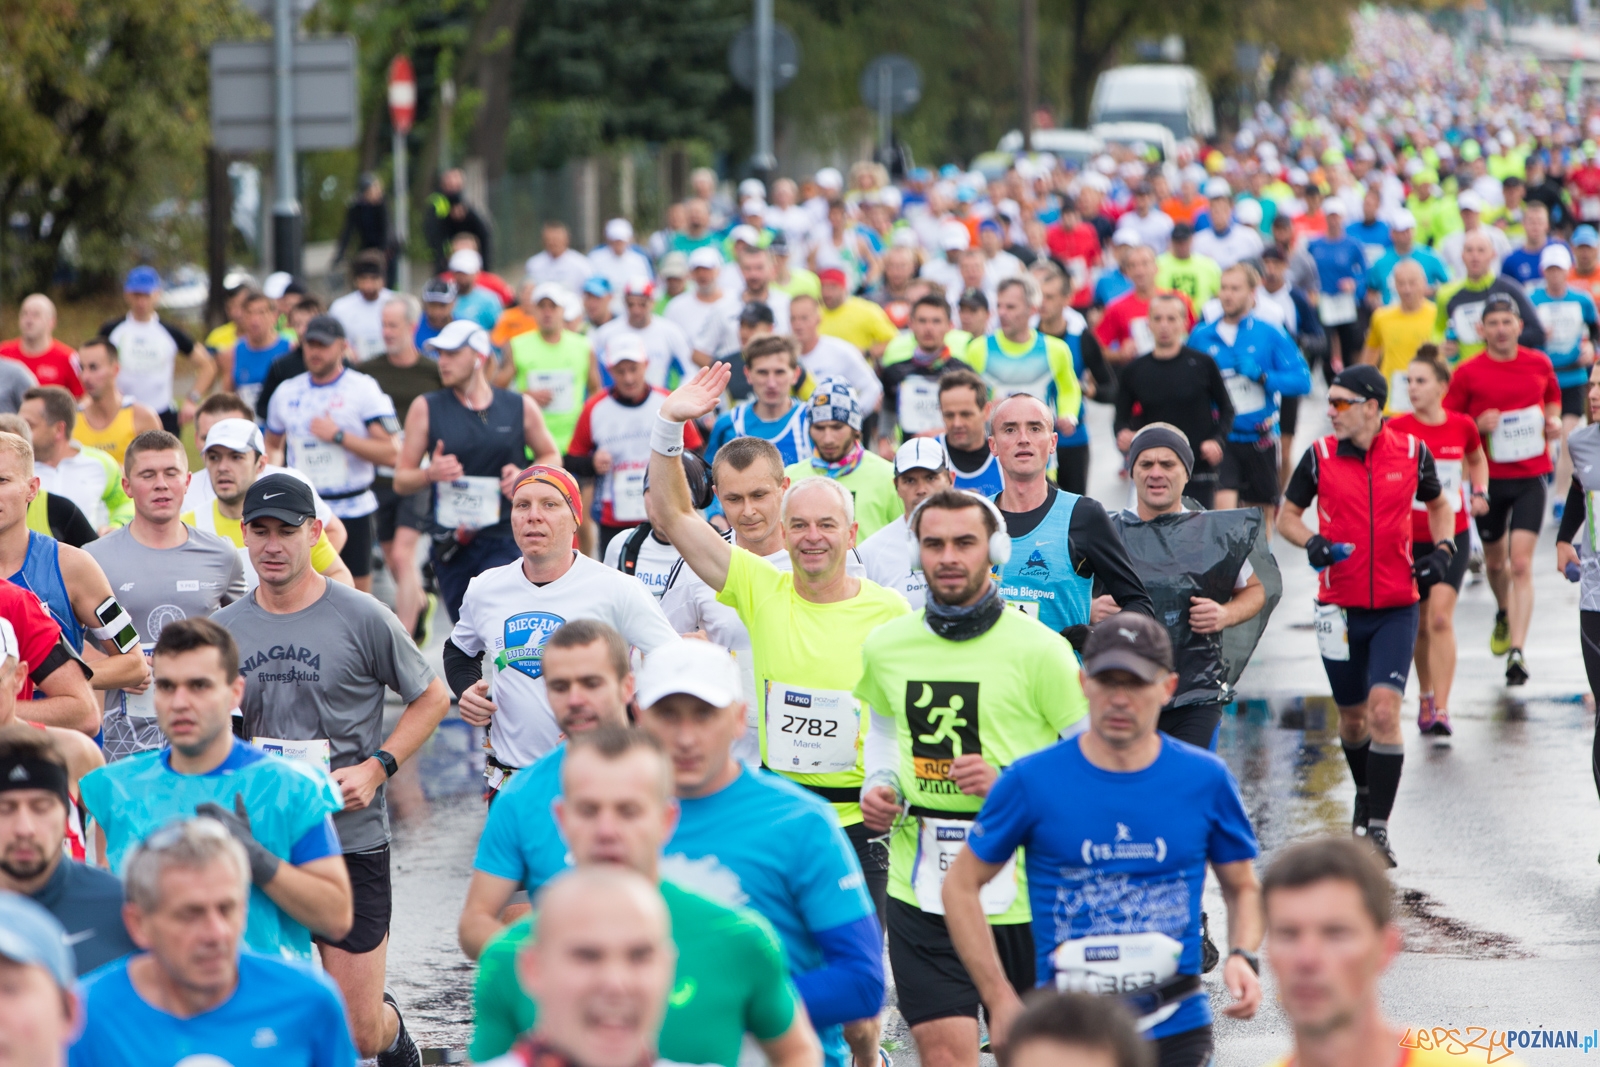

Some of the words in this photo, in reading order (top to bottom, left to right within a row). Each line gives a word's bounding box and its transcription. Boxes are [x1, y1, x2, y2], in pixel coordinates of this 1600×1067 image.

[998, 586, 1018, 596] emia
[1020, 587, 1055, 600] Biegowa
[507, 617, 562, 634] BIEGAM
[238, 643, 321, 678] NIAGARA
[258, 672, 292, 683] fitness
[297, 671, 321, 683] klub
[787, 694, 811, 705] 17.PKO
[781, 714, 839, 738] 2782
[793, 739, 822, 749] Marek
